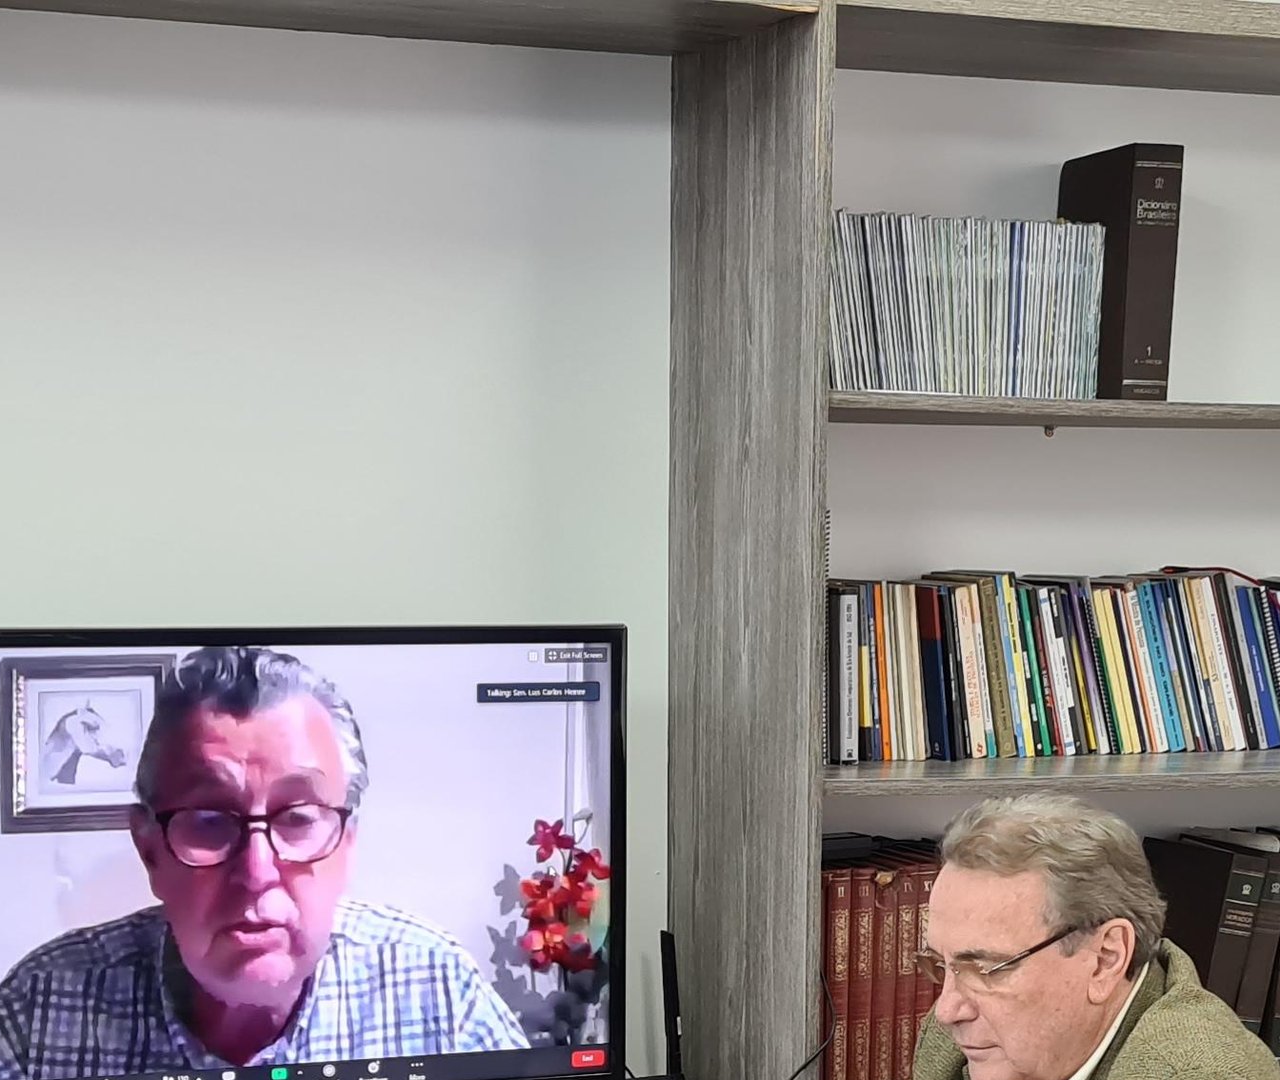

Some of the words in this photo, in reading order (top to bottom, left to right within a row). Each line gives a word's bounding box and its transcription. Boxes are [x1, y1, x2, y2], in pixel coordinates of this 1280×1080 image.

[1137, 199, 1177, 210] Dicionário
[1137, 209, 1177, 220] Brasileiro
[1146, 346, 1152, 356] 1
[1146, 599, 1158, 643] ELEIÇÕES
[1155, 645, 1161, 659] NO
[1163, 680, 1174, 717] GRANDE
